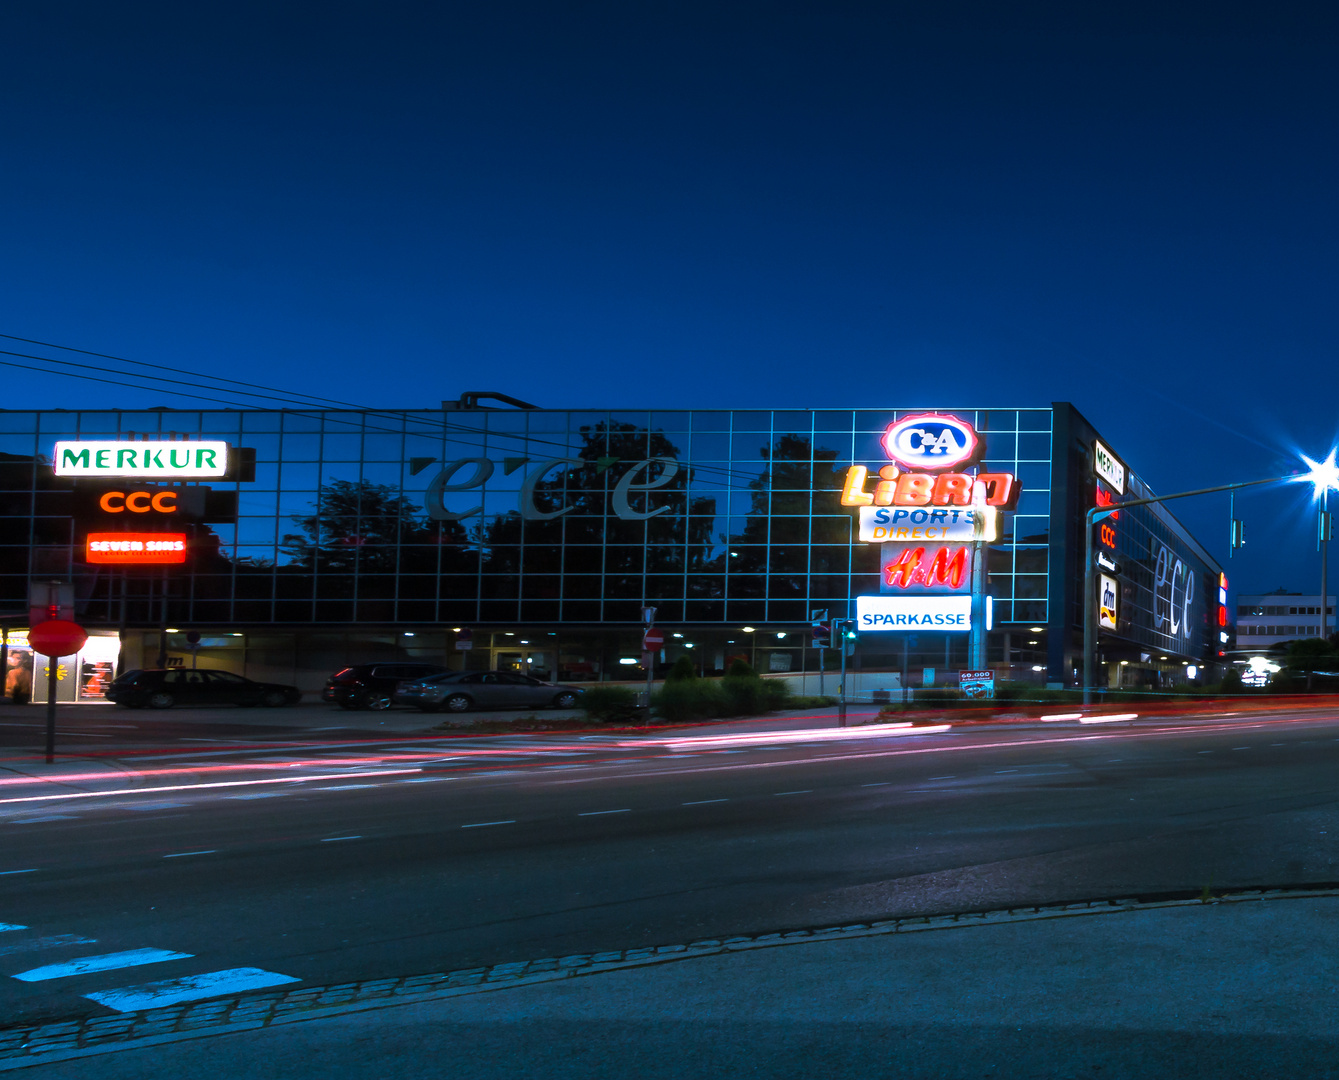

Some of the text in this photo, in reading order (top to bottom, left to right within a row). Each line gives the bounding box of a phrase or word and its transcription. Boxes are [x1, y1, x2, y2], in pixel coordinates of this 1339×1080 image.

[899, 428, 965, 454] C&A
[62, 449, 217, 469] MERKUR
[424, 456, 680, 521] ece
[100, 491, 177, 513] CCC
[872, 526, 951, 539] DIRECT
[1101, 524, 1116, 549] CCC
[90, 541, 184, 552] SEVEN SINS
[886, 546, 969, 589] H&M
[1104, 582, 1115, 609] dm
[863, 614, 965, 625] SPARKASSE
